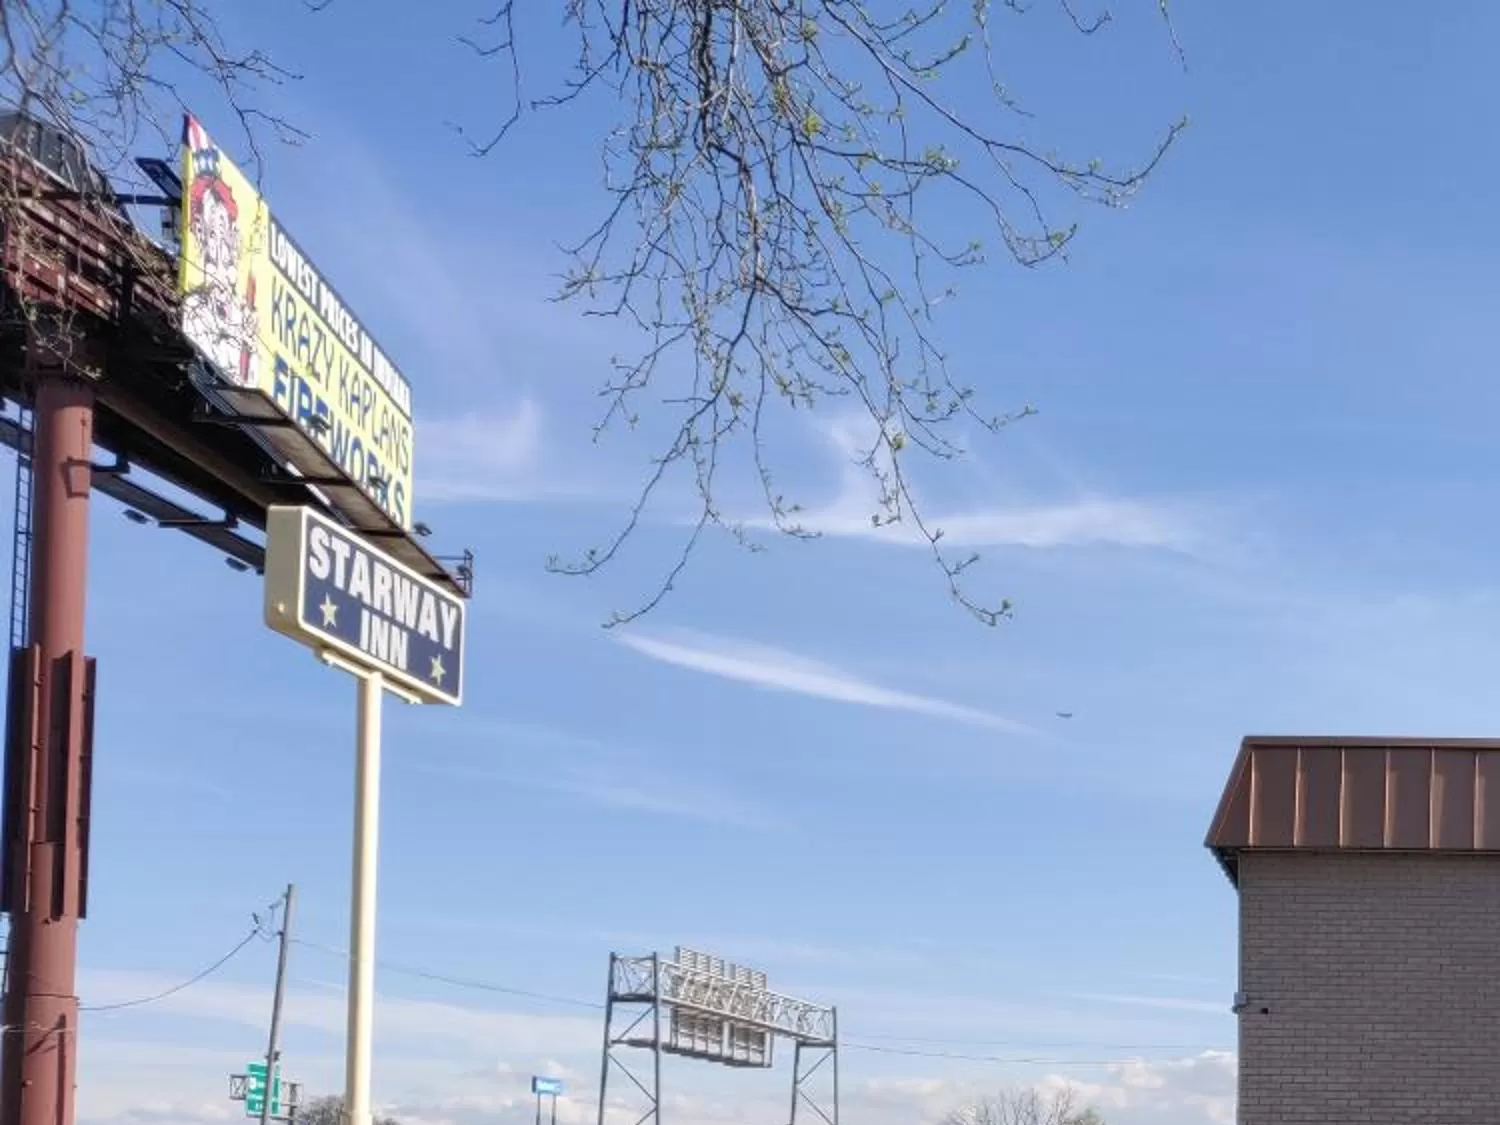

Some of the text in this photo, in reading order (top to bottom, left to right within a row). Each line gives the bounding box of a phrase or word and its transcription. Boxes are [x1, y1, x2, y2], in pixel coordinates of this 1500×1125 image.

[271, 222, 318, 307] LOWEST
[320, 281, 359, 353] PRICES
[271, 275, 409, 476] KRAZY KAPLANS
[273, 352, 405, 527] FIREWORKS
[309, 526, 457, 650] STARWAY
[360, 607, 409, 670] INN
